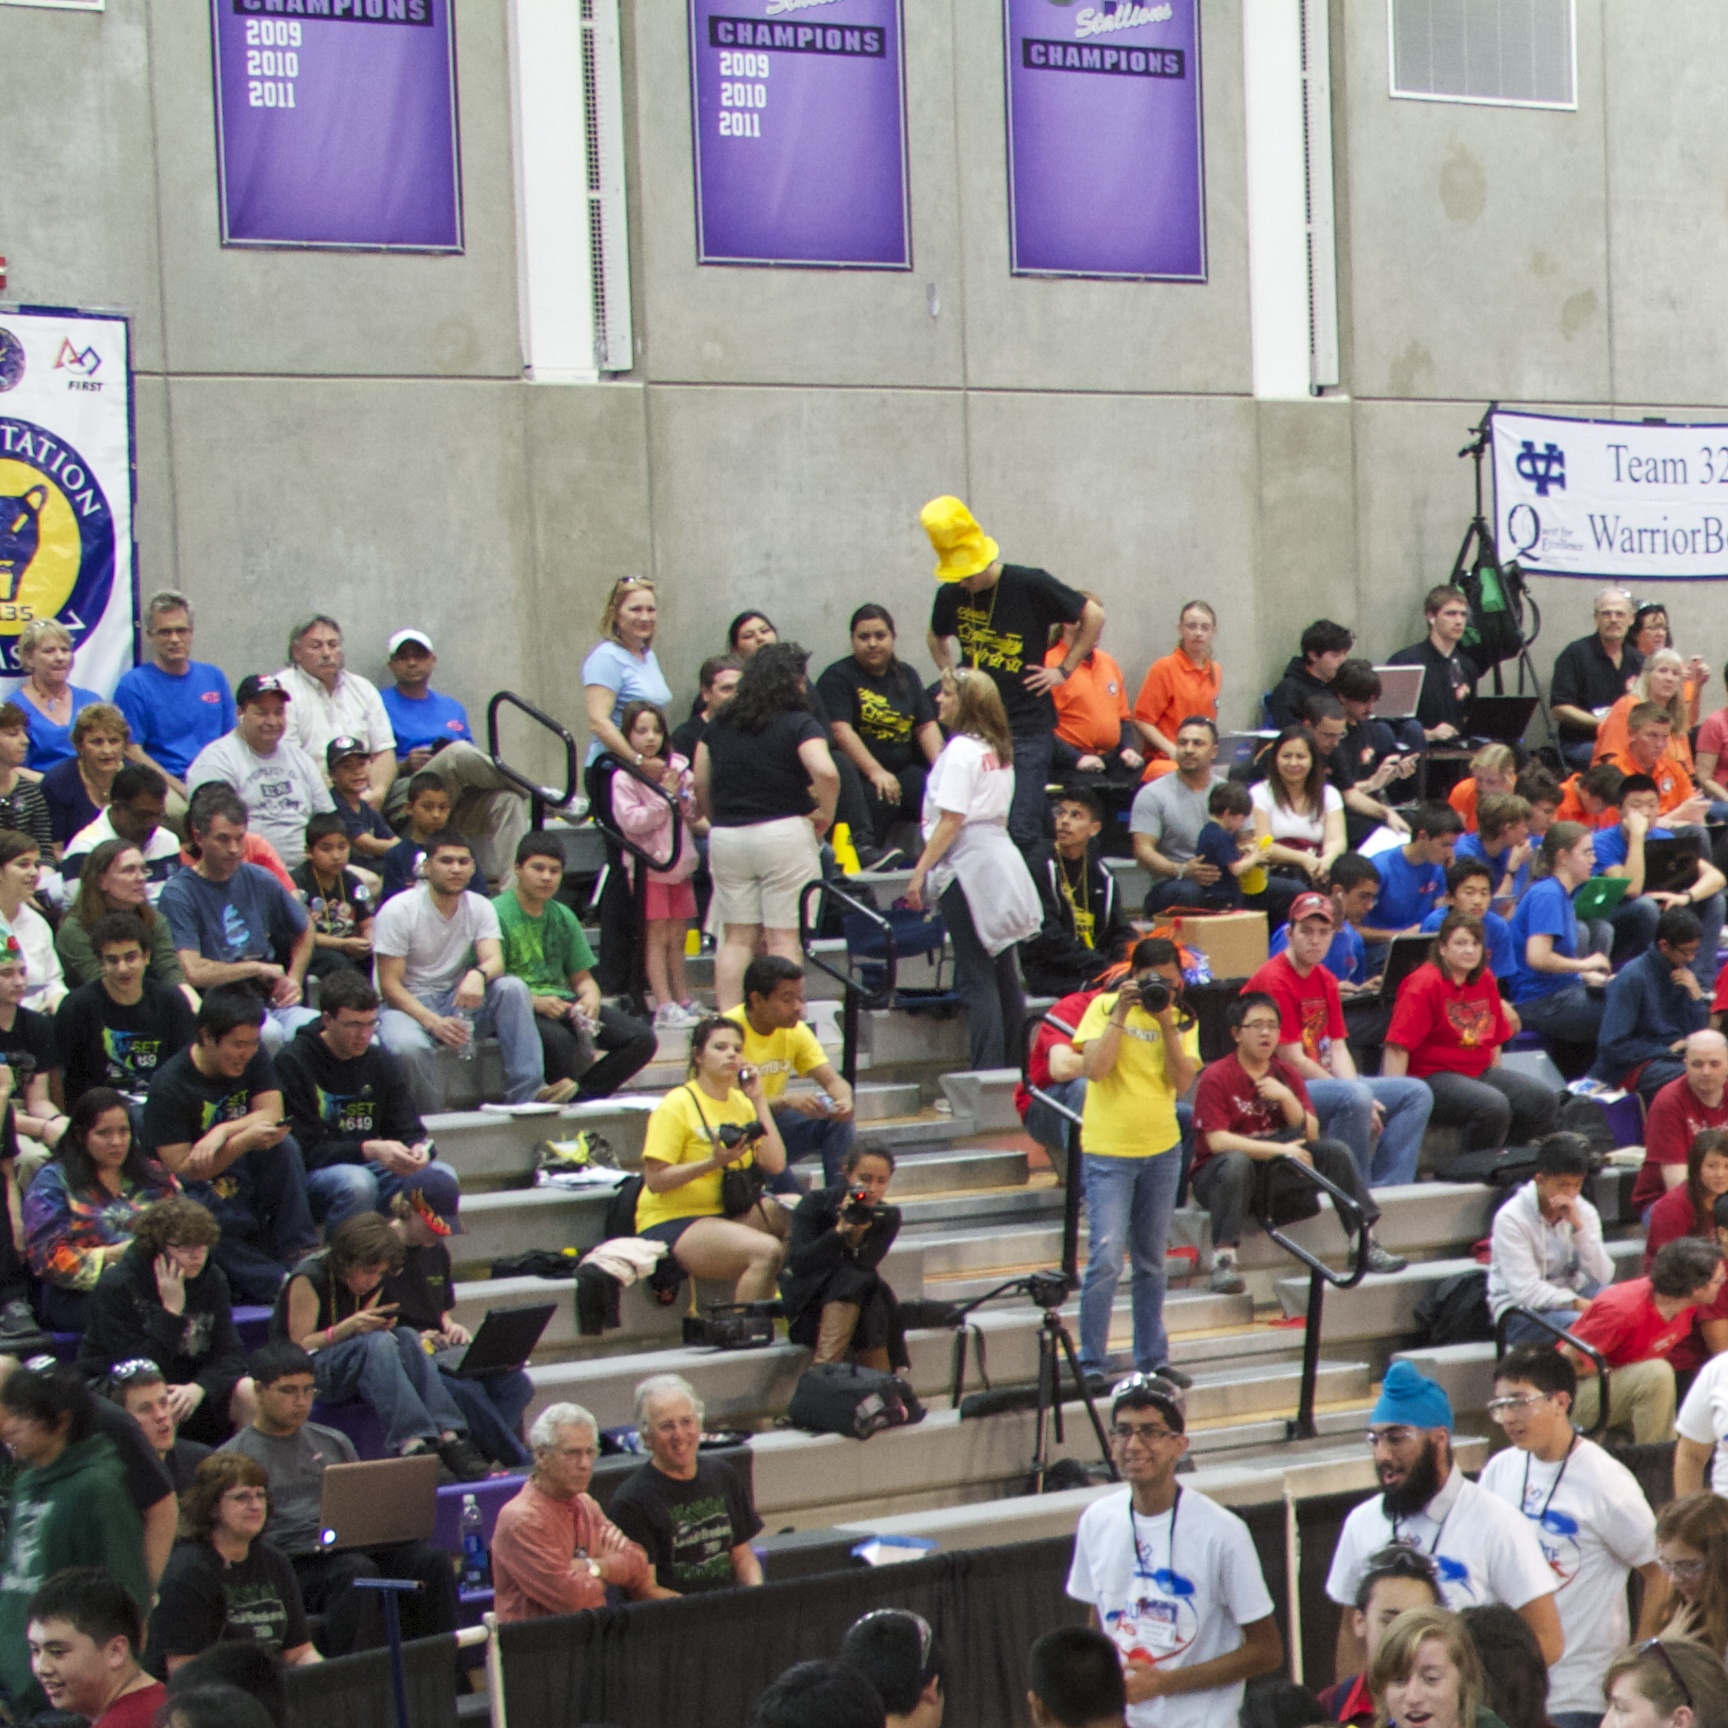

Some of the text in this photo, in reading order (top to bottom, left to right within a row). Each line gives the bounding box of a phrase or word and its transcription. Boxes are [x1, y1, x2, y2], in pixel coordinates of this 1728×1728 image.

[246, 19, 302, 47] 2009
[1073, 2, 1173, 39] Stallions
[717, 21, 881, 53] CHAMPIONS
[247, 50, 299, 78] 2010
[720, 51, 770, 78] 2009
[1030, 43, 1180, 75] CHAMPIONS
[248, 81, 296, 109] 2011
[721, 82, 767, 108] 2010
[719, 111, 761, 138] 2011
[68, 381, 103, 392] FIRST
[1606, 444, 1689, 484] Team
